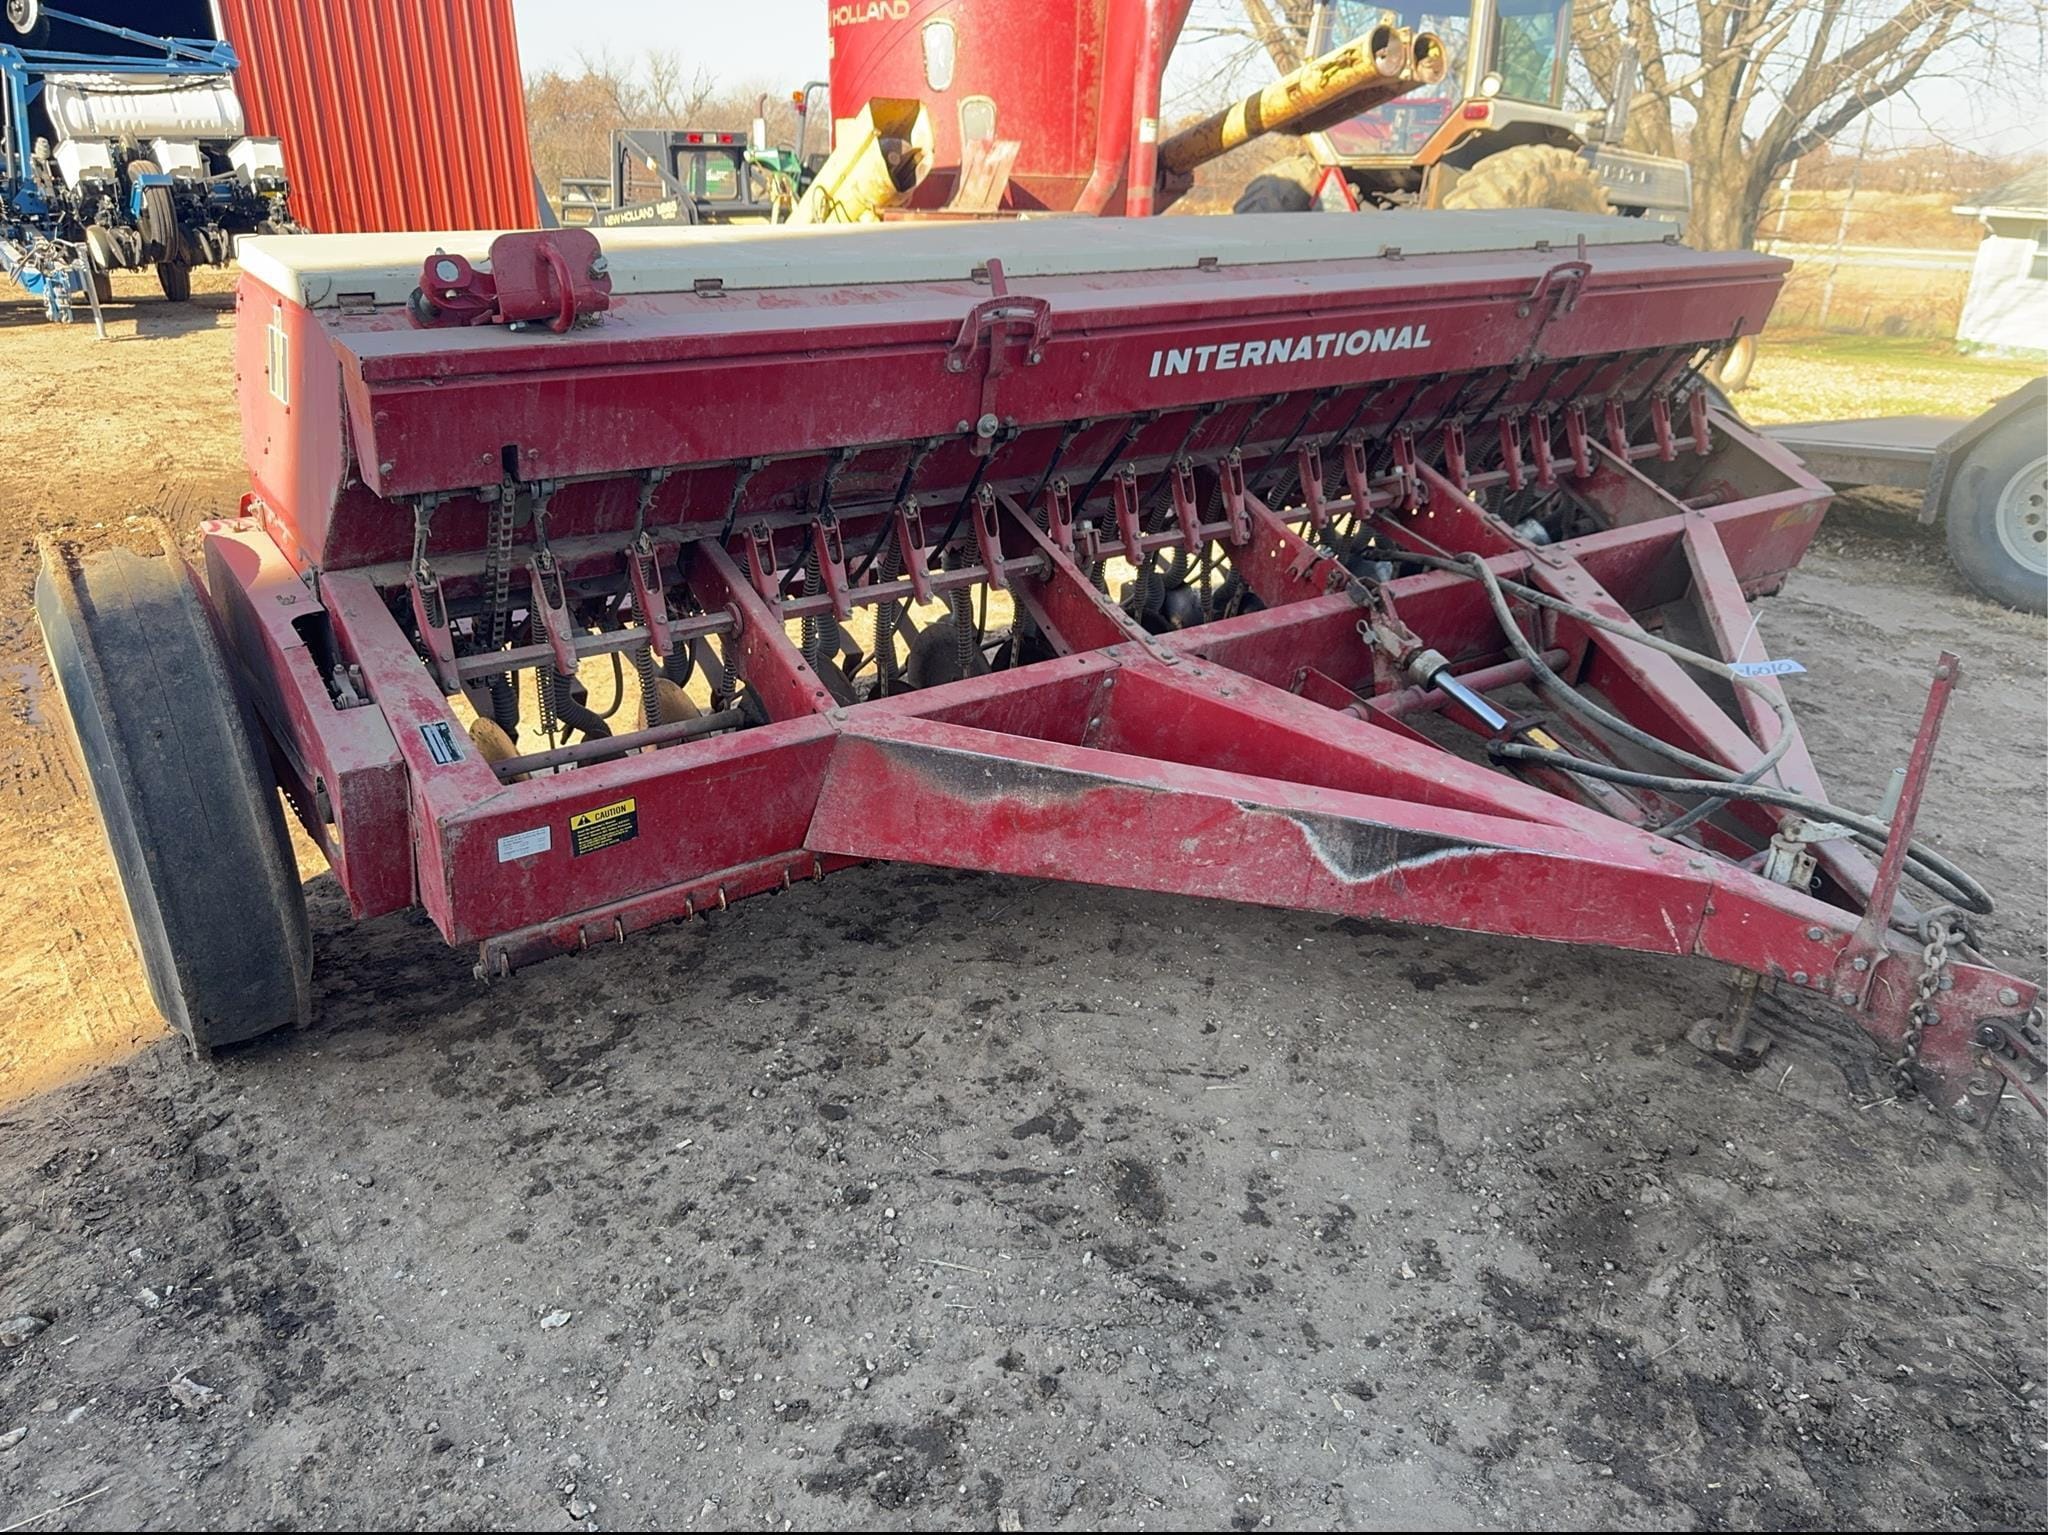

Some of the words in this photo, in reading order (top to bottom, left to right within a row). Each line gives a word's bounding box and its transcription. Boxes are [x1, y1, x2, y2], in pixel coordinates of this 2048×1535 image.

[832, 0, 910, 27] HOLLAND
[604, 213, 620, 226] NEW
[621, 206, 654, 223] HOLLAND
[1149, 324, 1431, 377] INTERNATIONAL
[594, 804, 627, 821] CAUTION
